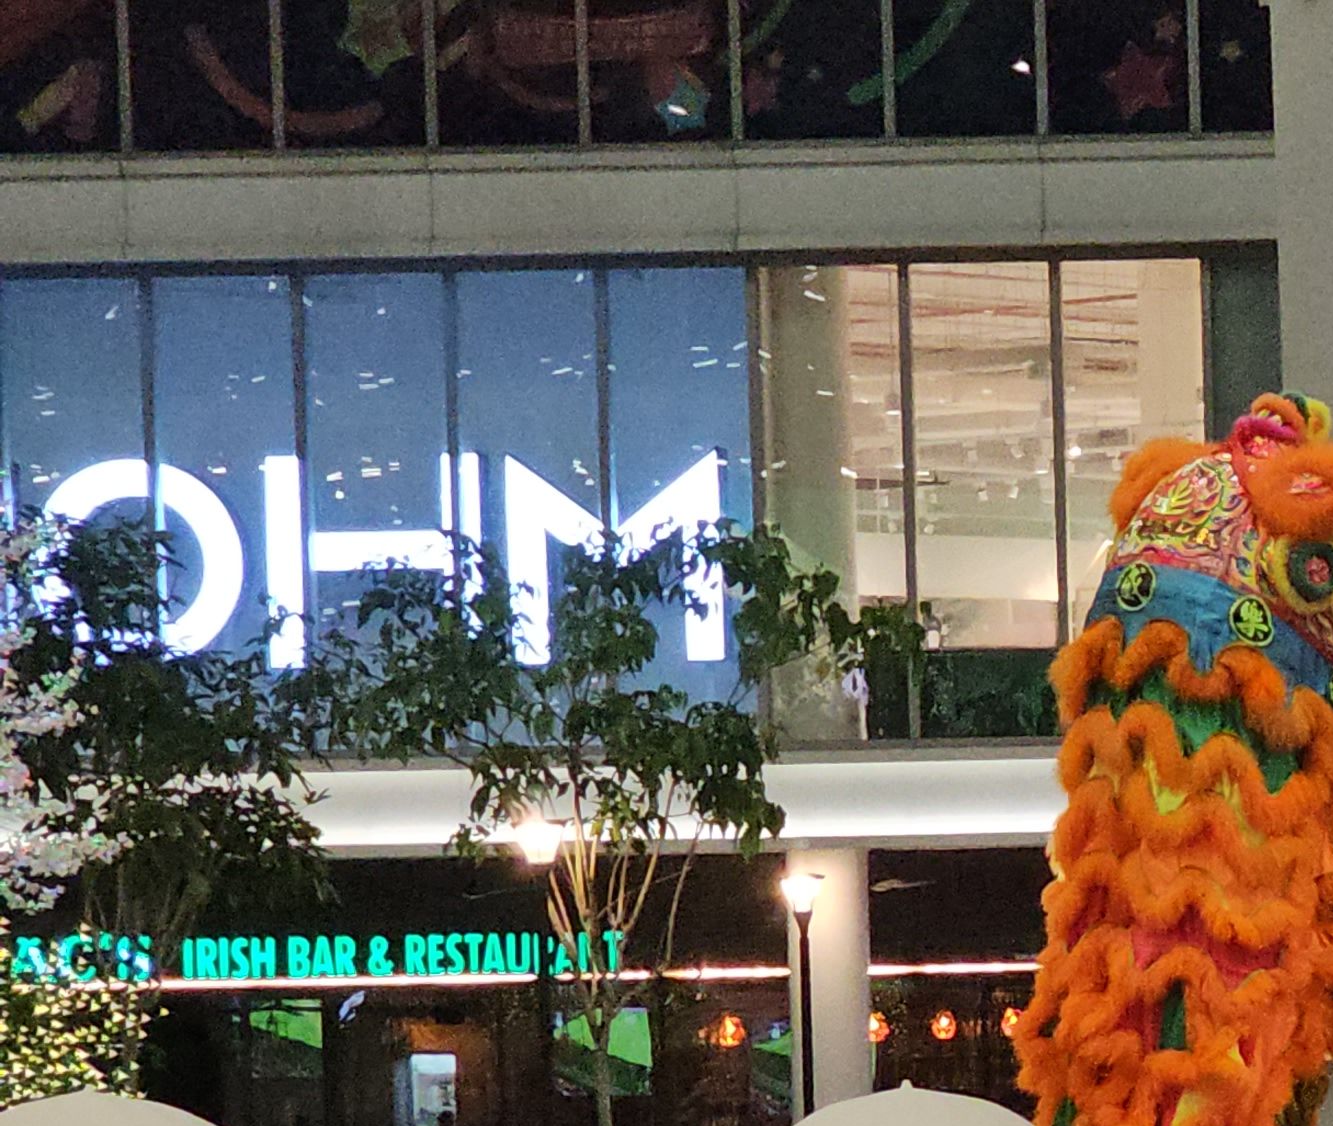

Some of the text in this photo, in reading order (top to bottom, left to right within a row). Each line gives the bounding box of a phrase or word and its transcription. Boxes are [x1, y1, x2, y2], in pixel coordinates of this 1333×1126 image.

[182, 936, 276, 980] IRISH
[287, 935, 357, 979] BAR
[367, 935, 394, 977] &
